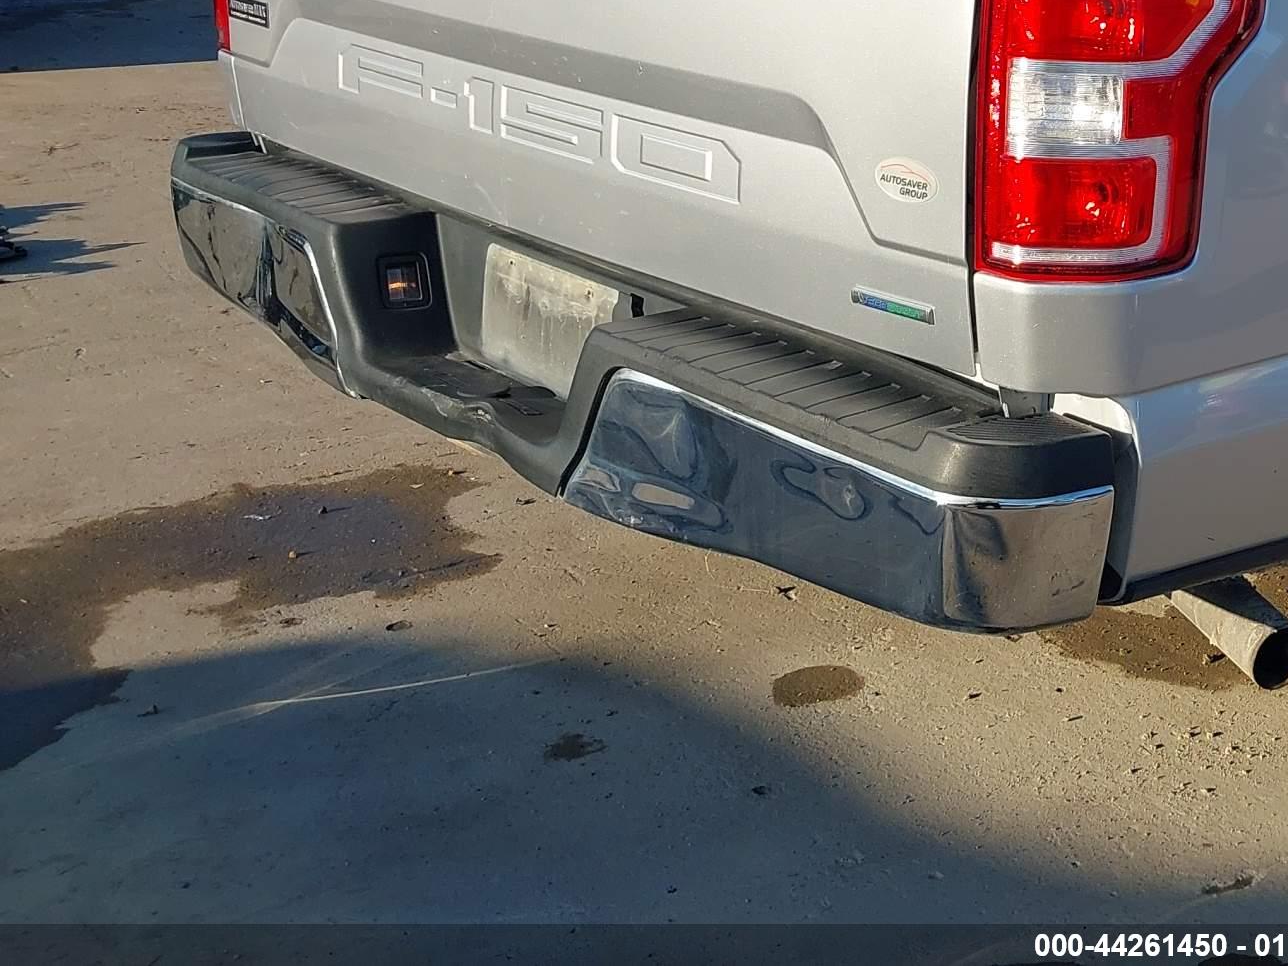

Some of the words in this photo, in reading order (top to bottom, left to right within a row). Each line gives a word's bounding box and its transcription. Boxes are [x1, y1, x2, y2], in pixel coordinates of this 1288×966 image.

[337, 42, 742, 204] F-150
[880, 173, 929, 192] AUTOSAVER
[899, 187, 928, 200] GROUP
